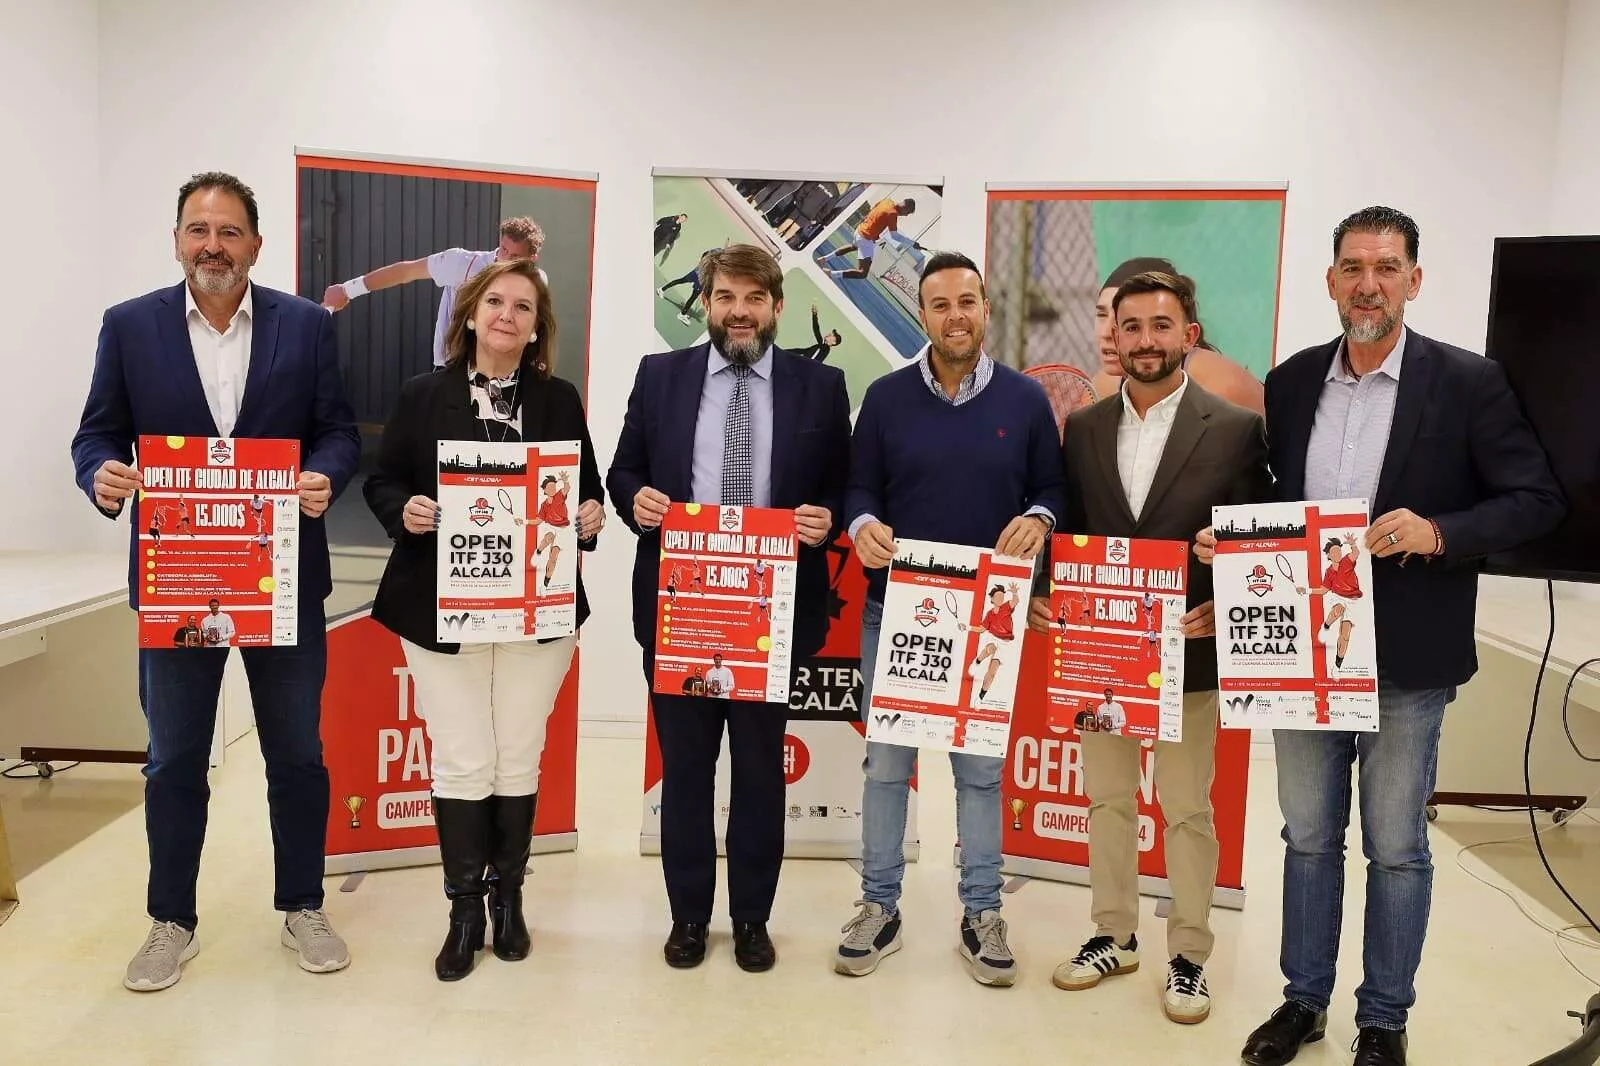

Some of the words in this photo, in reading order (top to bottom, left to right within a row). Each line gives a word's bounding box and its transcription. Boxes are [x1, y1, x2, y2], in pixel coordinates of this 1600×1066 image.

[143, 467, 172, 488] OPEN
[175, 468, 192, 488] ITF
[195, 468, 237, 489] CIUDAD
[240, 469, 253, 489] DE
[256, 466, 296, 490] ALCALÁ
[195, 503, 245, 529] 15.000$
[450, 534, 512, 549] OPEN
[665, 530, 689, 550] OPEN
[692, 532, 705, 551] ITF
[707, 532, 743, 553] CIUDAD
[745, 535, 758, 554] DE
[760, 533, 795, 557] ALCALÁ
[450, 552, 477, 565] ITF
[482, 552, 513, 565] J30
[450, 564, 512, 578] ALCALÁ
[705, 565, 750, 591] 15.000$
[1054, 561, 1078, 581] OPEN
[1080, 563, 1093, 583] ITF
[1095, 564, 1131, 587] CIUDAD
[1133, 567, 1145, 588] DE
[1147, 566, 1183, 590] ALCALÁ
[1095, 598, 1138, 624] 15.000$
[1229, 605, 1295, 623] OPEN
[1230, 625, 1258, 639] ITF
[1264, 625, 1298, 639] J30
[892, 633, 953, 654] OPEN
[1231, 640, 1298, 655] ALCALÁ
[889, 650, 917, 665] ITF
[921, 653, 952, 669] J30
[818, 667, 865, 688] TEN
[887, 665, 949, 683] ALCALÁ
[788, 687, 859, 711] CALÁ
